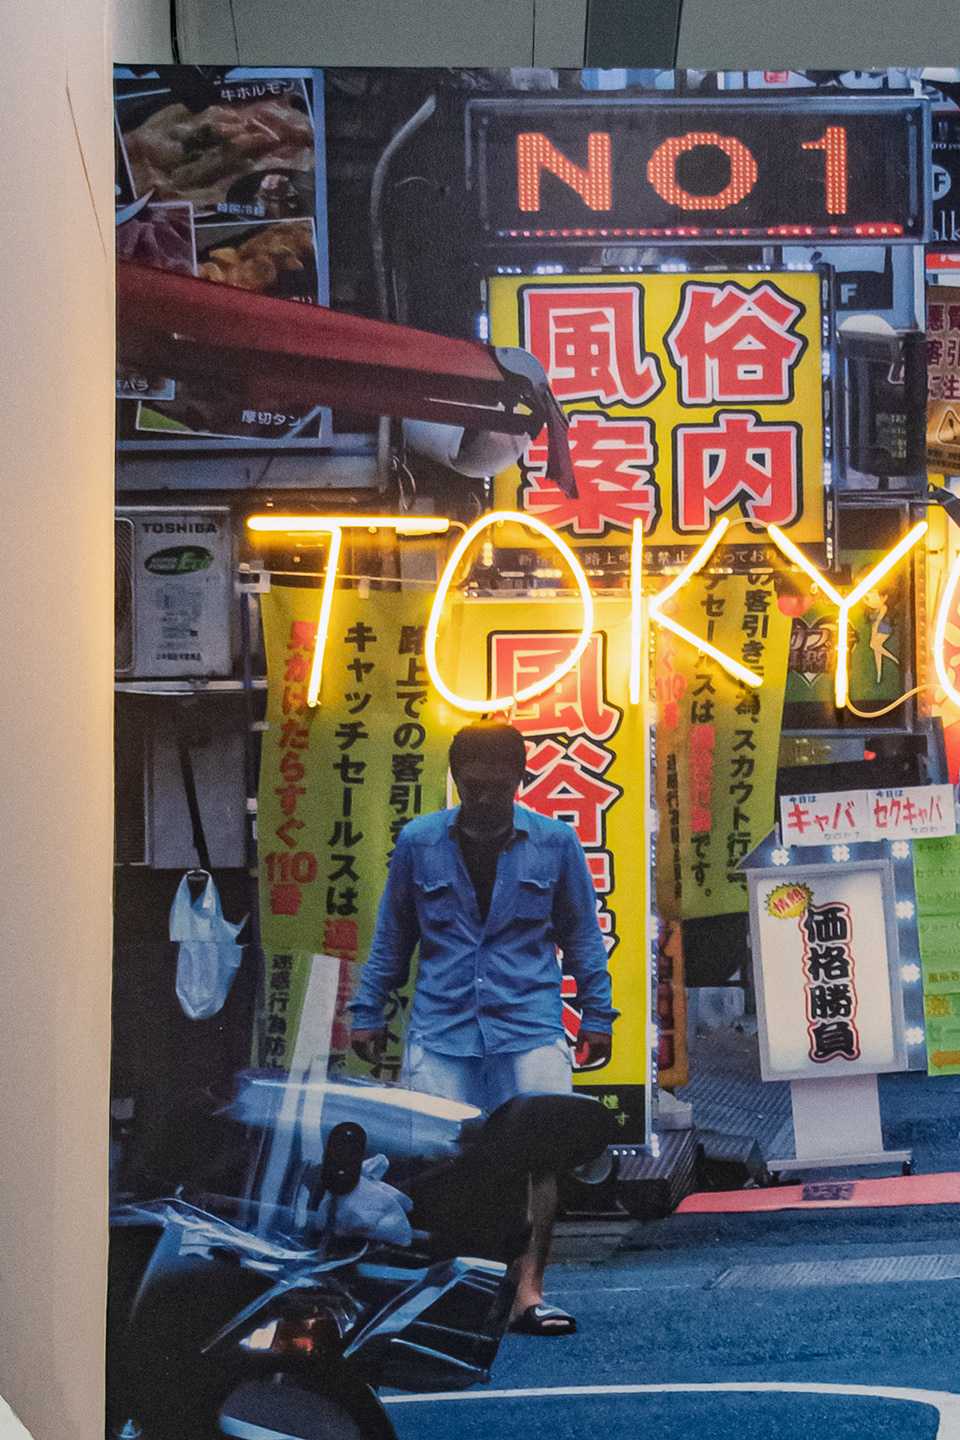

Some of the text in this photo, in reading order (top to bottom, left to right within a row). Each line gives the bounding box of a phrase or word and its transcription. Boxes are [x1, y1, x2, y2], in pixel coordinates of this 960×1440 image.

[518, 281, 808, 407] 風俗
[141, 523, 217, 534] TOSHIBA
[518, 409, 803, 536] 案内
[788, 800, 856, 834] キャバ
[800, 902, 859, 1062] 価格勝負
